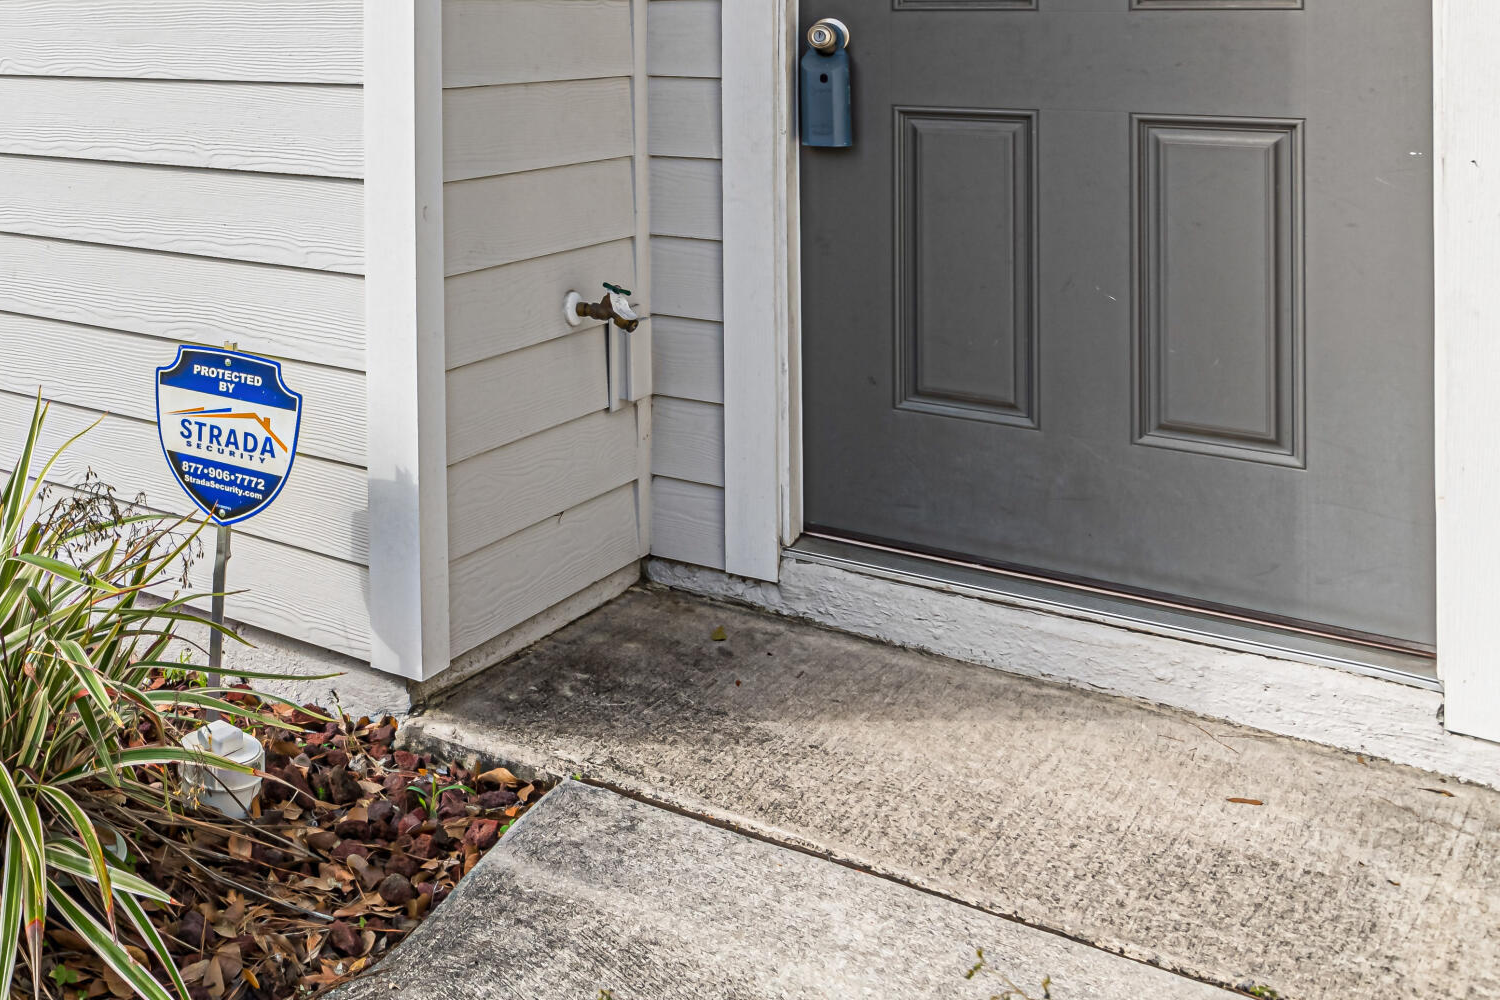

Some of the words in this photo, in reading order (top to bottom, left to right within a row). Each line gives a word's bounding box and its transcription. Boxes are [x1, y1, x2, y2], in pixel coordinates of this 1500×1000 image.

[193, 364, 263, 387] PROTECTED
[219, 381, 235, 393] BY
[180, 418, 276, 459] STRADA
[186, 440, 266, 464] SECURITY
[184, 474, 263, 500] StradaSecurity.com
